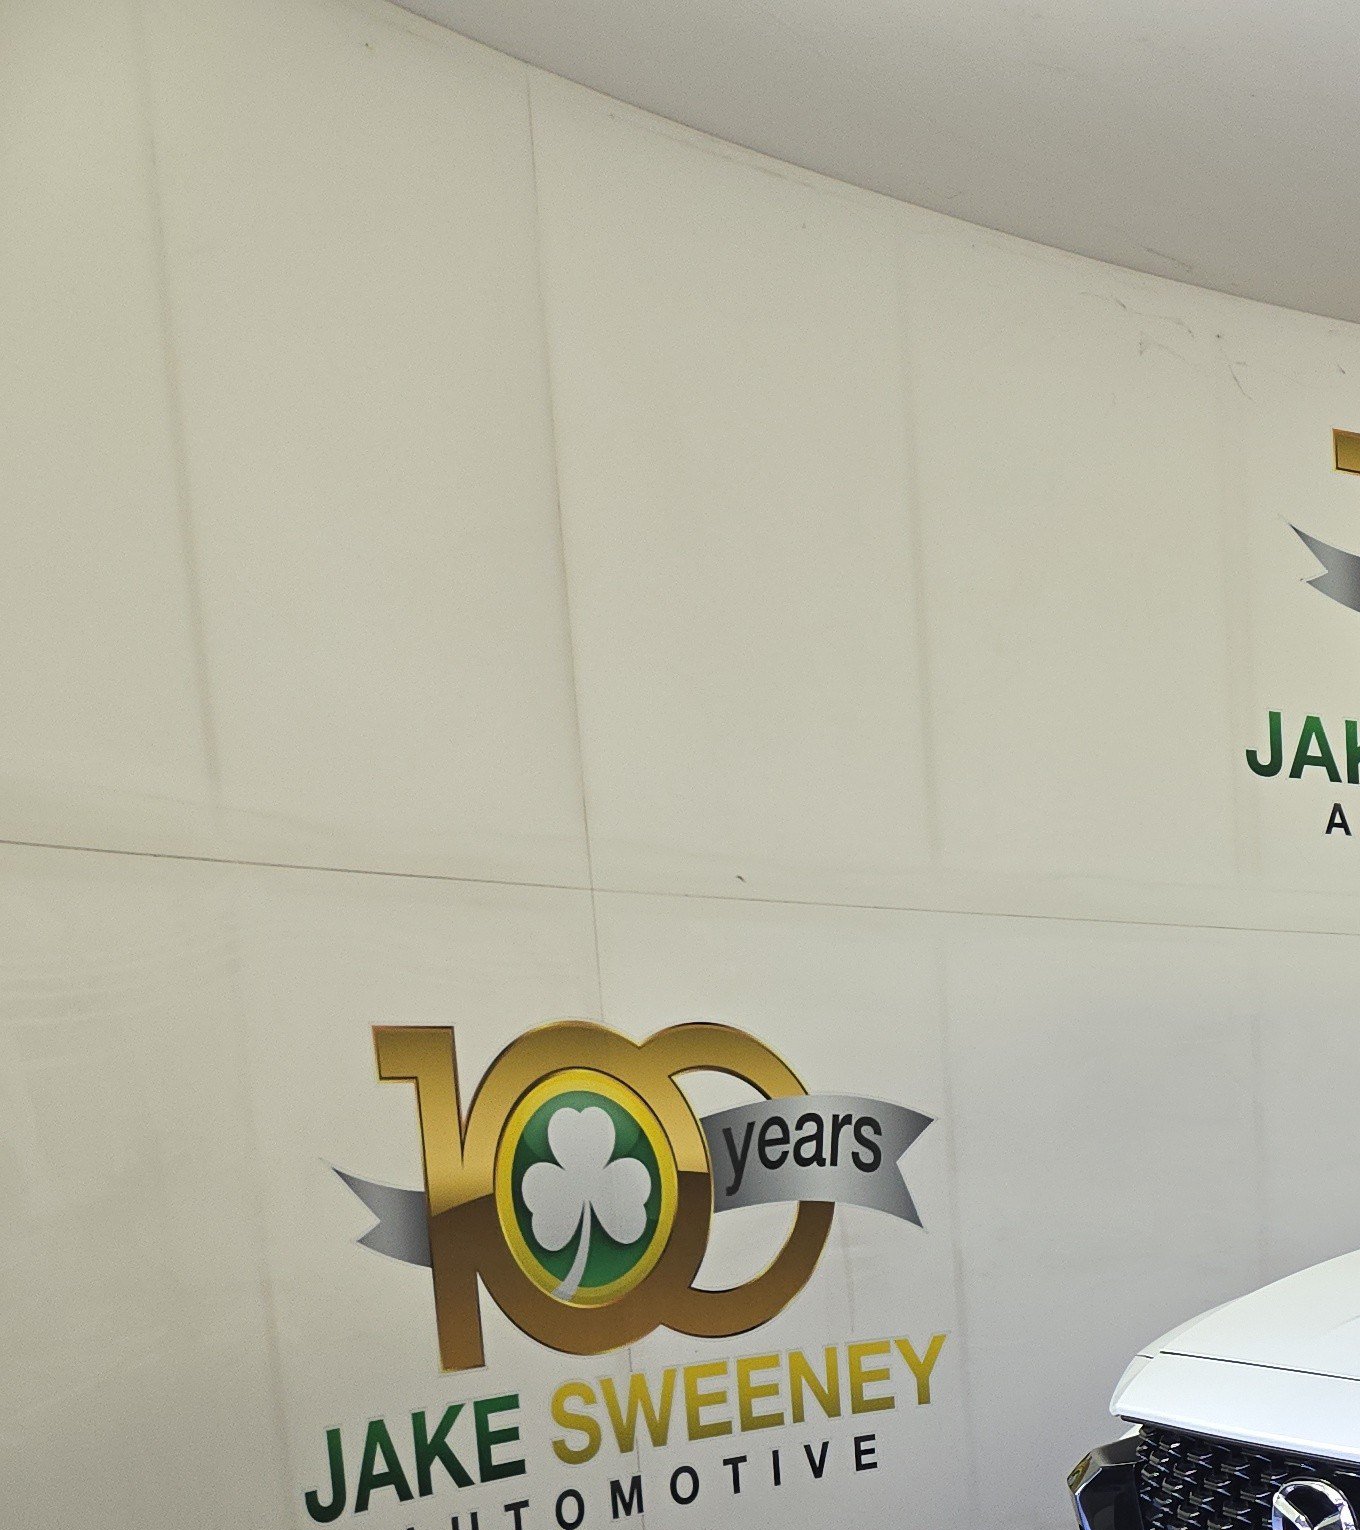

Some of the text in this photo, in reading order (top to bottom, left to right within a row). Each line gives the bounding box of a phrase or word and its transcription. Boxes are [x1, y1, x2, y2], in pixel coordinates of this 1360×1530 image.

[722, 1112, 883, 1196] years
[304, 1334, 947, 1523] JAKE SWEENEY
